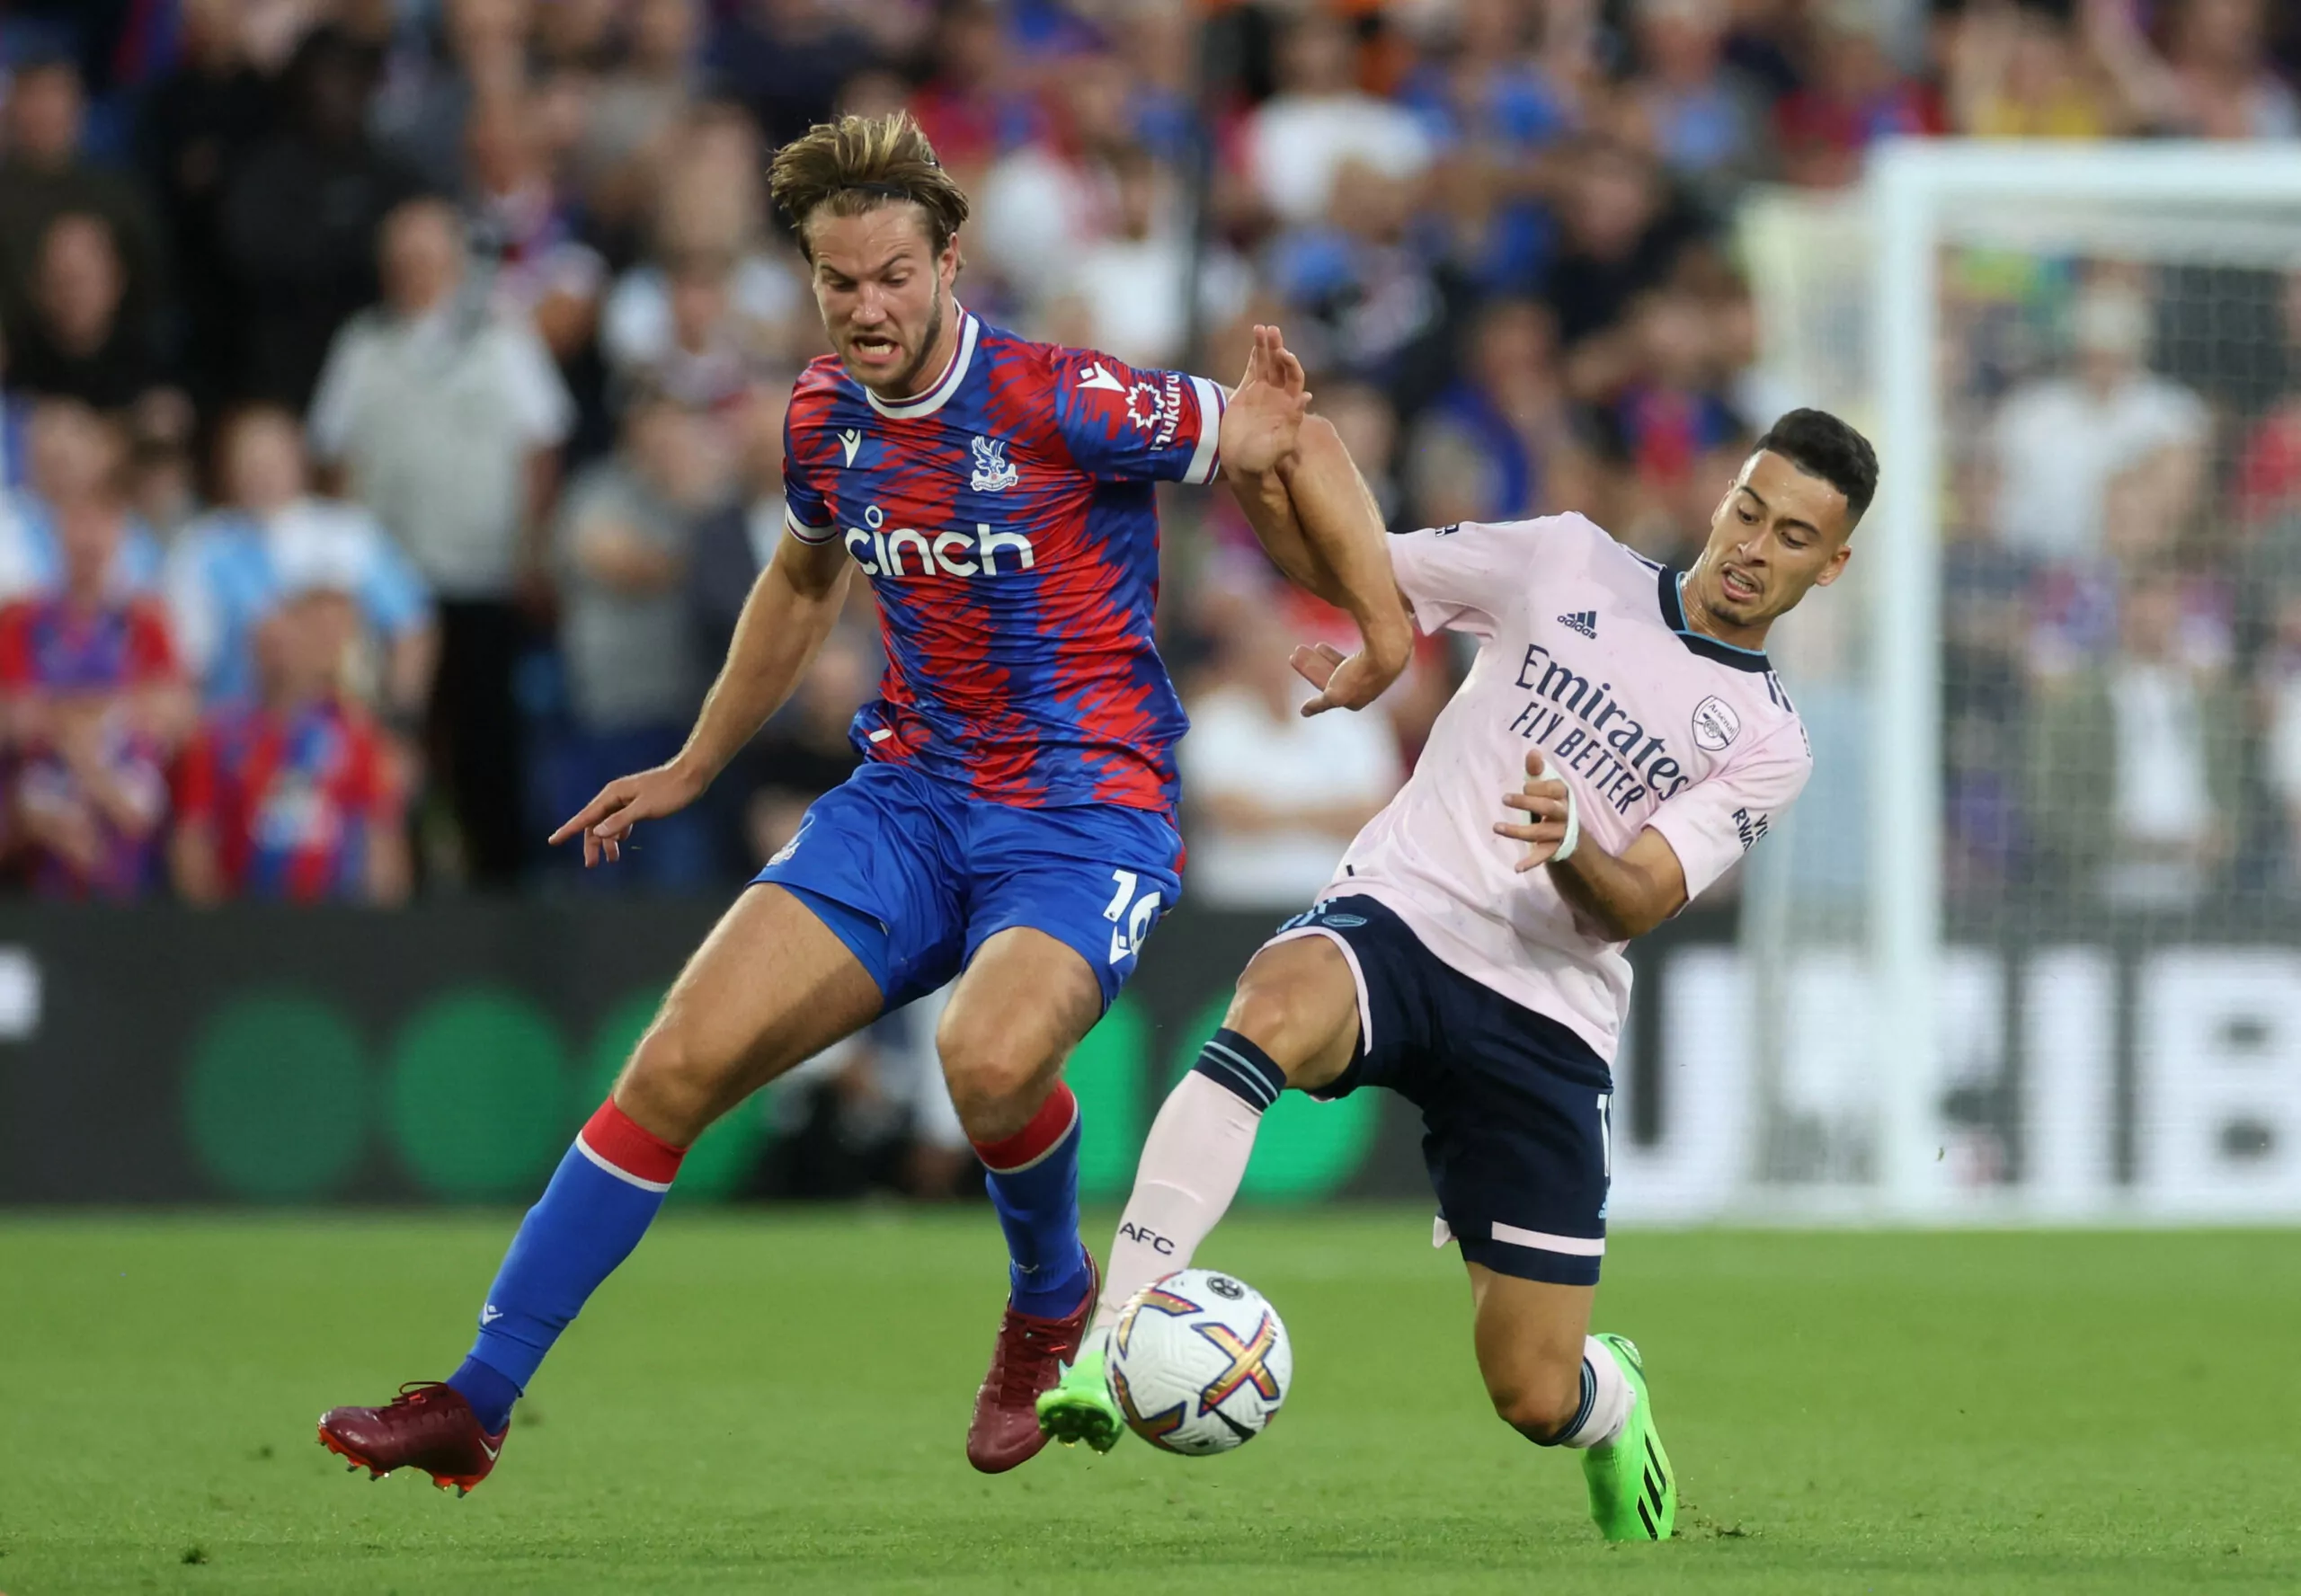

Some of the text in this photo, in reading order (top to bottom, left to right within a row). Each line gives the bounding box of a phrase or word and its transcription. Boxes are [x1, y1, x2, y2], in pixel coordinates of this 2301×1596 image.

[845, 505, 1035, 577] cinch
[1557, 614, 1597, 640] adidas
[1510, 701, 1647, 815] FLY BETTER
[1515, 643, 1689, 802] Emirates
[1102, 869, 1161, 956] 16
[1119, 1222, 1176, 1256] AFC
